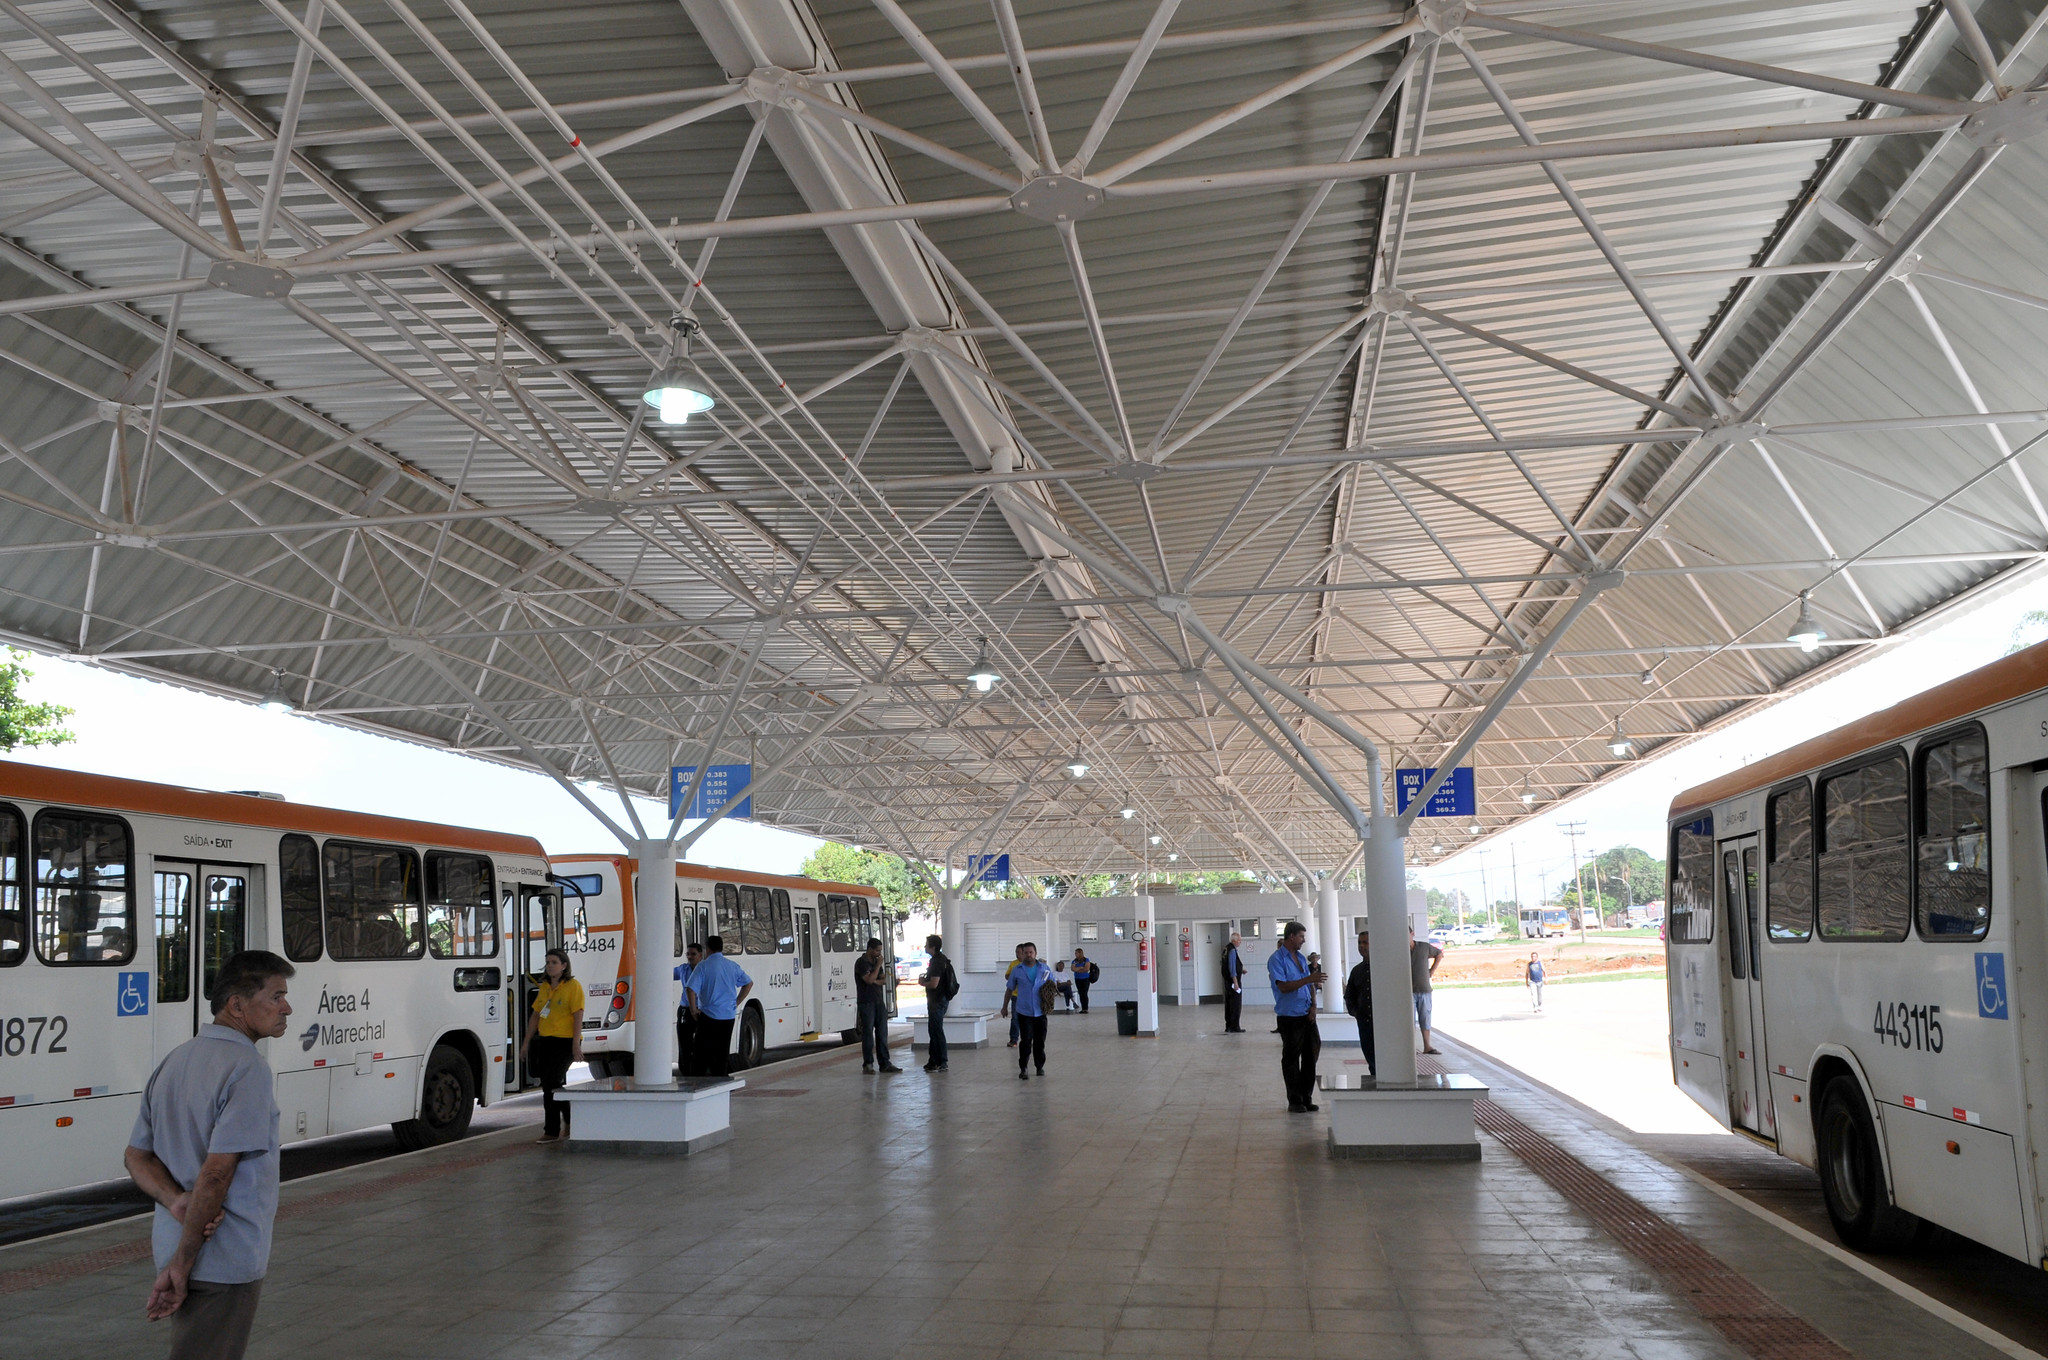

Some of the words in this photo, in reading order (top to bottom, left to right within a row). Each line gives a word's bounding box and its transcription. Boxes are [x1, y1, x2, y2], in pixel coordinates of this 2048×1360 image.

[677, 771, 694, 783] BOX
[1403, 775, 1420, 786] BOX
[183, 833, 209, 847] SAÍDA
[215, 838, 233, 849] EXIT
[496, 865, 518, 874] ENTRADA
[520, 867, 544, 877] ENTRANCE
[769, 973, 792, 988] 443484
[317, 983, 356, 1014] Área
[360, 988, 370, 1010] 4
[321, 1019, 386, 1046] Marechal
[1873, 1000, 1944, 1054] 443115
